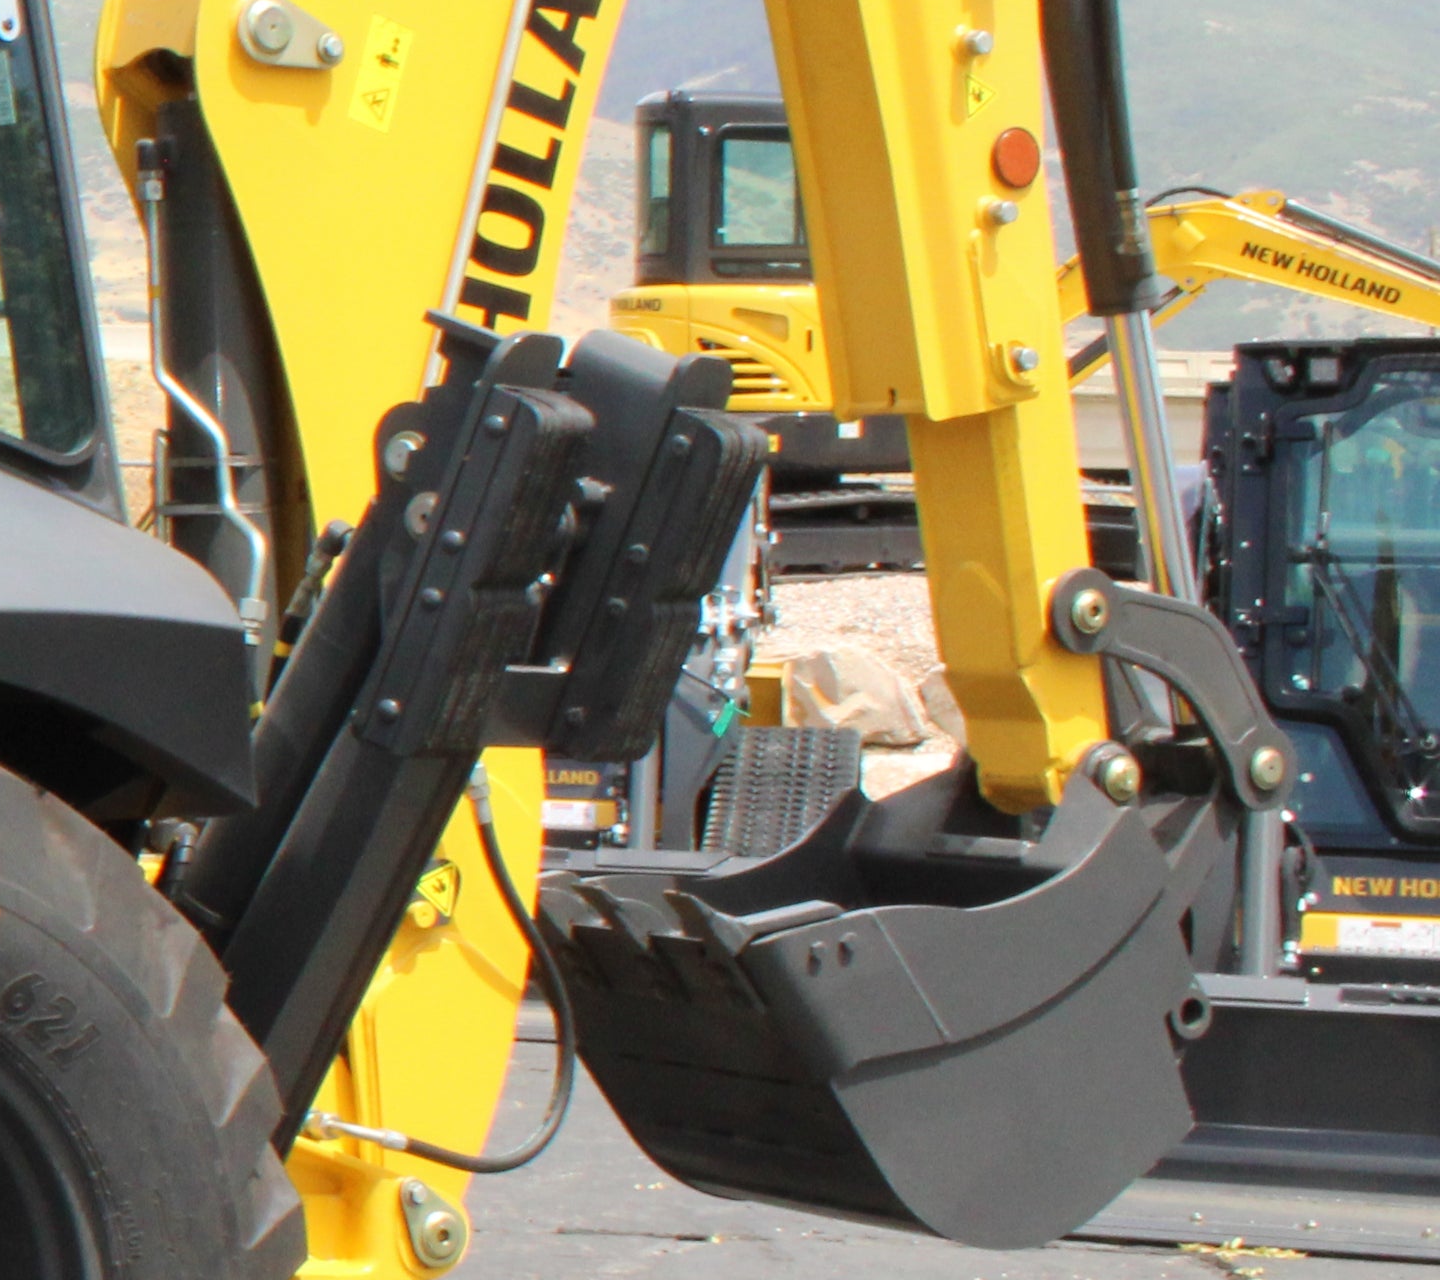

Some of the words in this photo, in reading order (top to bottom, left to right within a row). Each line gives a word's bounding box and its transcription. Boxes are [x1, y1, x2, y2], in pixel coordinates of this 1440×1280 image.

[1240, 241, 1295, 270] NEW
[1297, 254, 1403, 304] HOLLAND
[1332, 875, 1396, 897] NEW
[1399, 876, 1440, 898] HO
